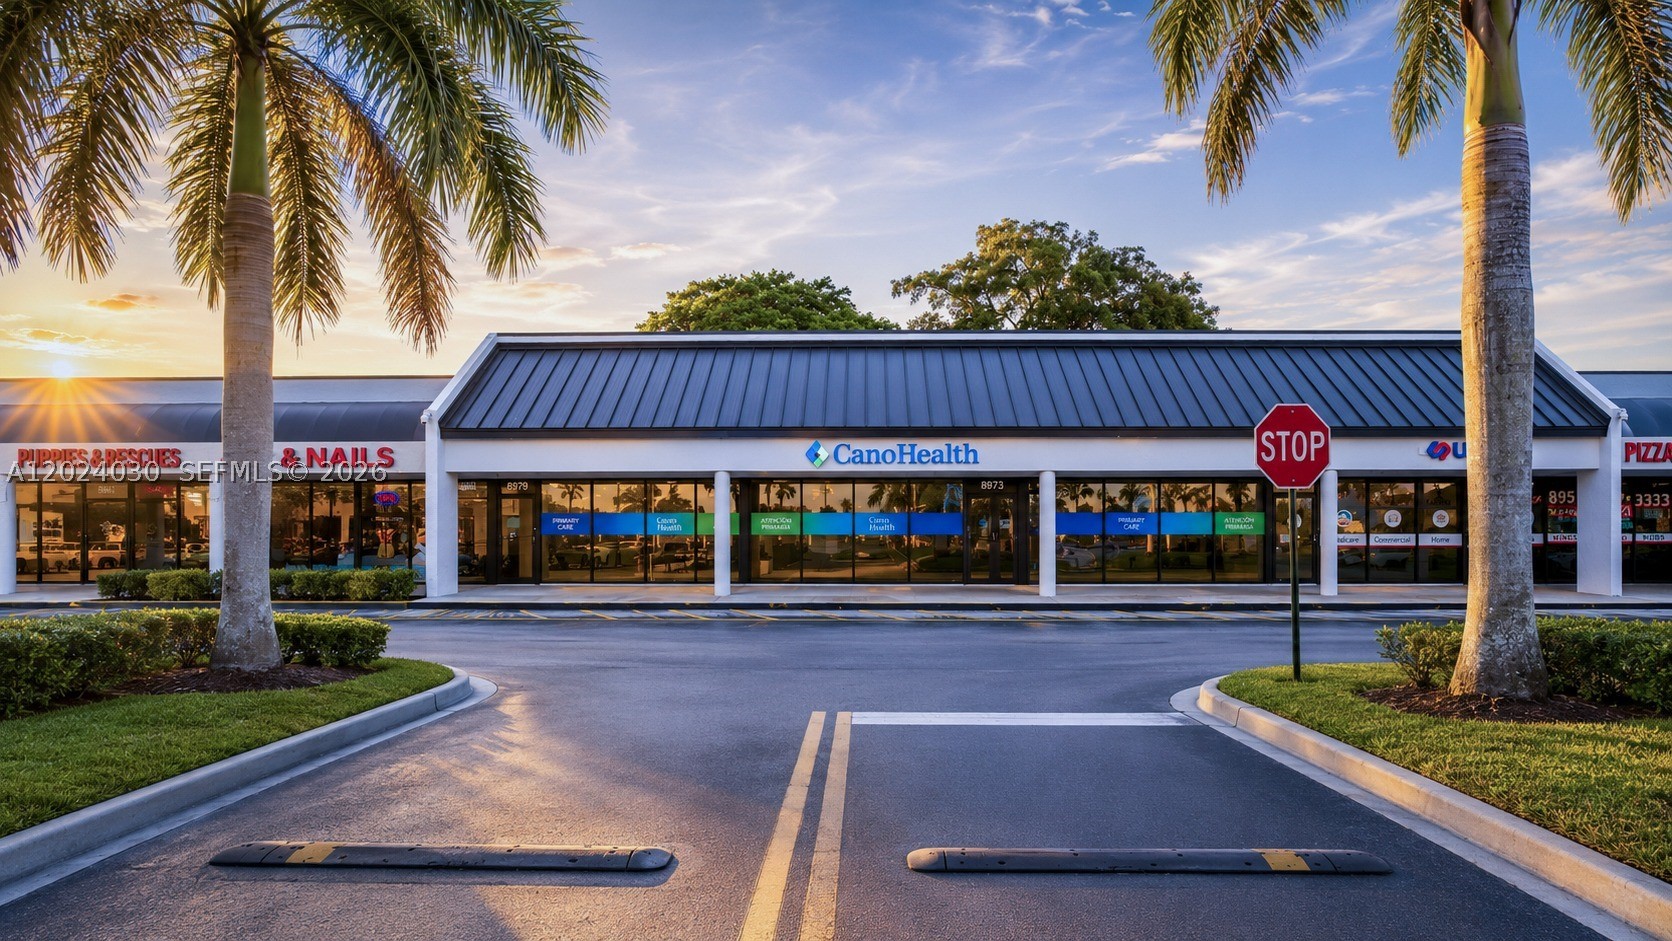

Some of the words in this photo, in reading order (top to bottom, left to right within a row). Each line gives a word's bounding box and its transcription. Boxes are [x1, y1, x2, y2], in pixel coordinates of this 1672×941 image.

[833, 443, 980, 465] CanoHealth
[1260, 430, 1326, 462] STOP
[1624, 442, 1672, 463] PIZZA
[17, 448, 88, 468] PUPPIES
[104, 448, 183, 468] RESCUES
[281, 447, 300, 469] &
[305, 447, 395, 469] NAILS
[506, 482, 529, 491] 8979
[981, 481, 1004, 490] 8973
[1634, 493, 1670, 506] 3333
